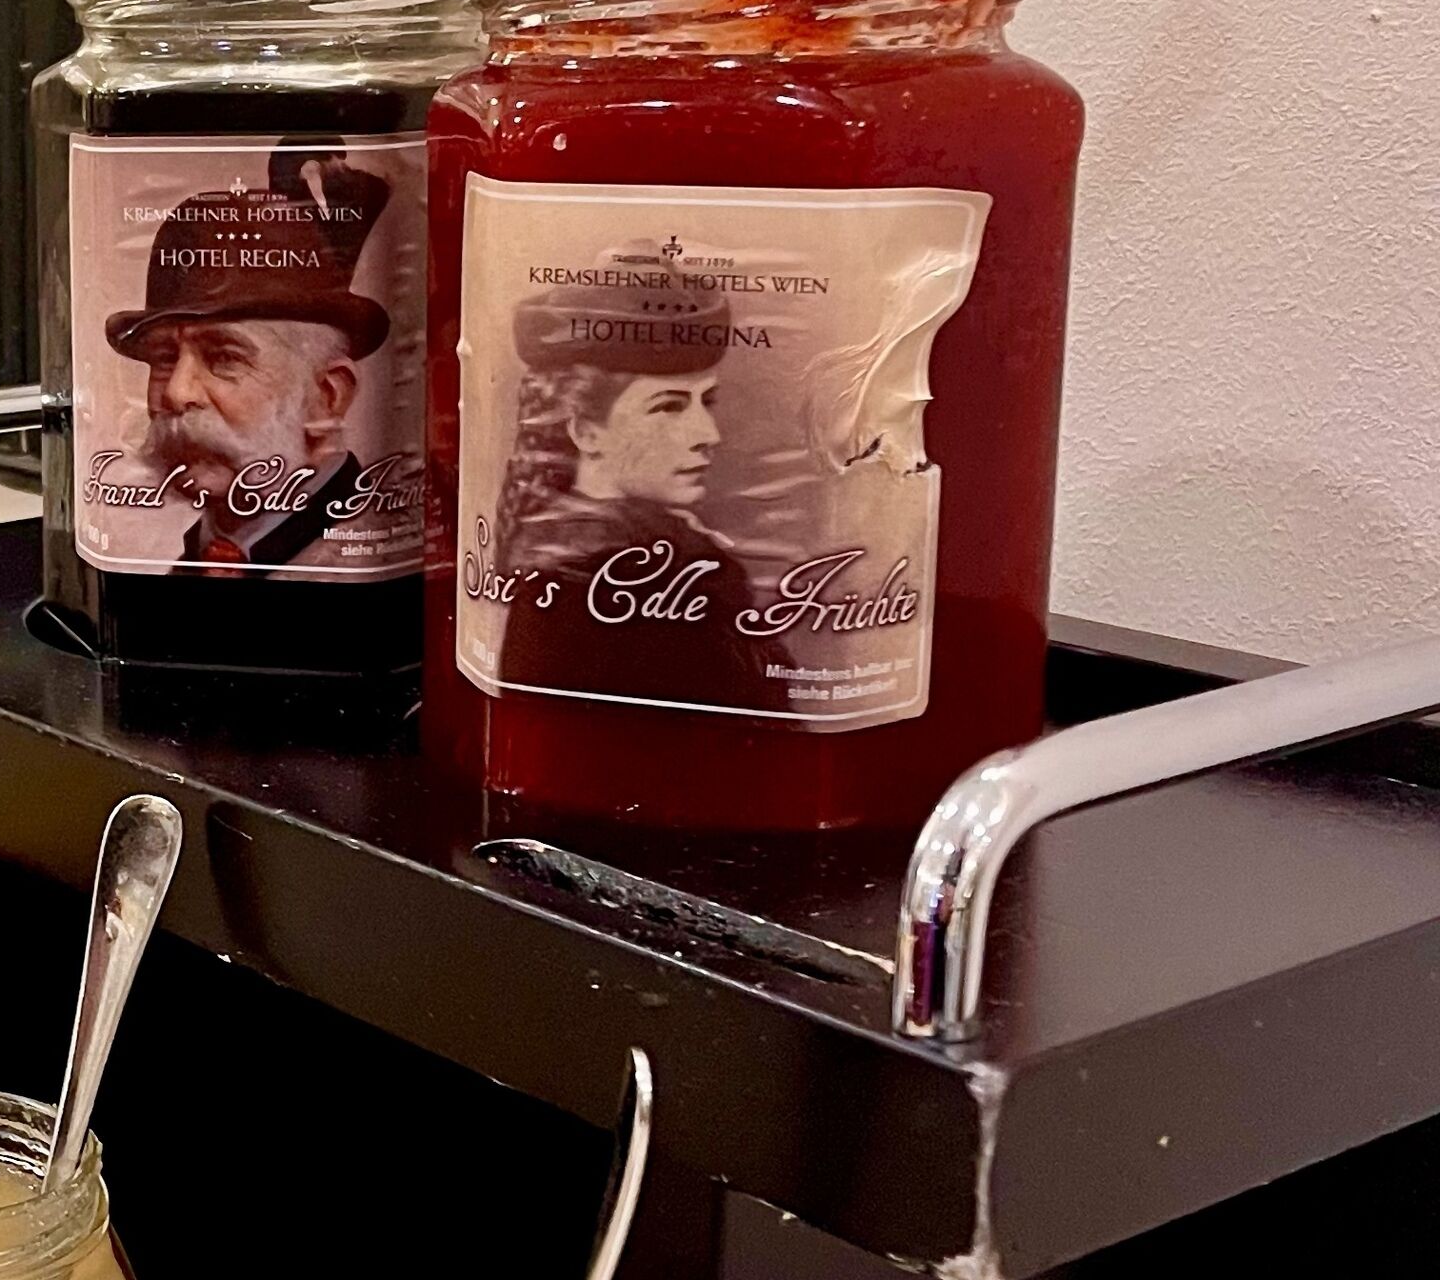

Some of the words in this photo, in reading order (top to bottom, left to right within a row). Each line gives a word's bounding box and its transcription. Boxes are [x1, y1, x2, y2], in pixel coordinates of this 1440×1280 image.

[122, 207, 240, 222] KREMSLEHNER
[247, 206, 314, 222] HOTELS
[317, 207, 363, 222] WIEN
[160, 249, 235, 268] HOTEL
[240, 248, 321, 268] REGINA
[529, 267, 672, 290] KREMSLEHNER
[682, 272, 765, 293] HOTELS
[771, 275, 831, 295] WIEN
[570, 318, 664, 345] HOTEL
[670, 322, 773, 349] REGINA
[736, 549, 918, 636] Früchte
